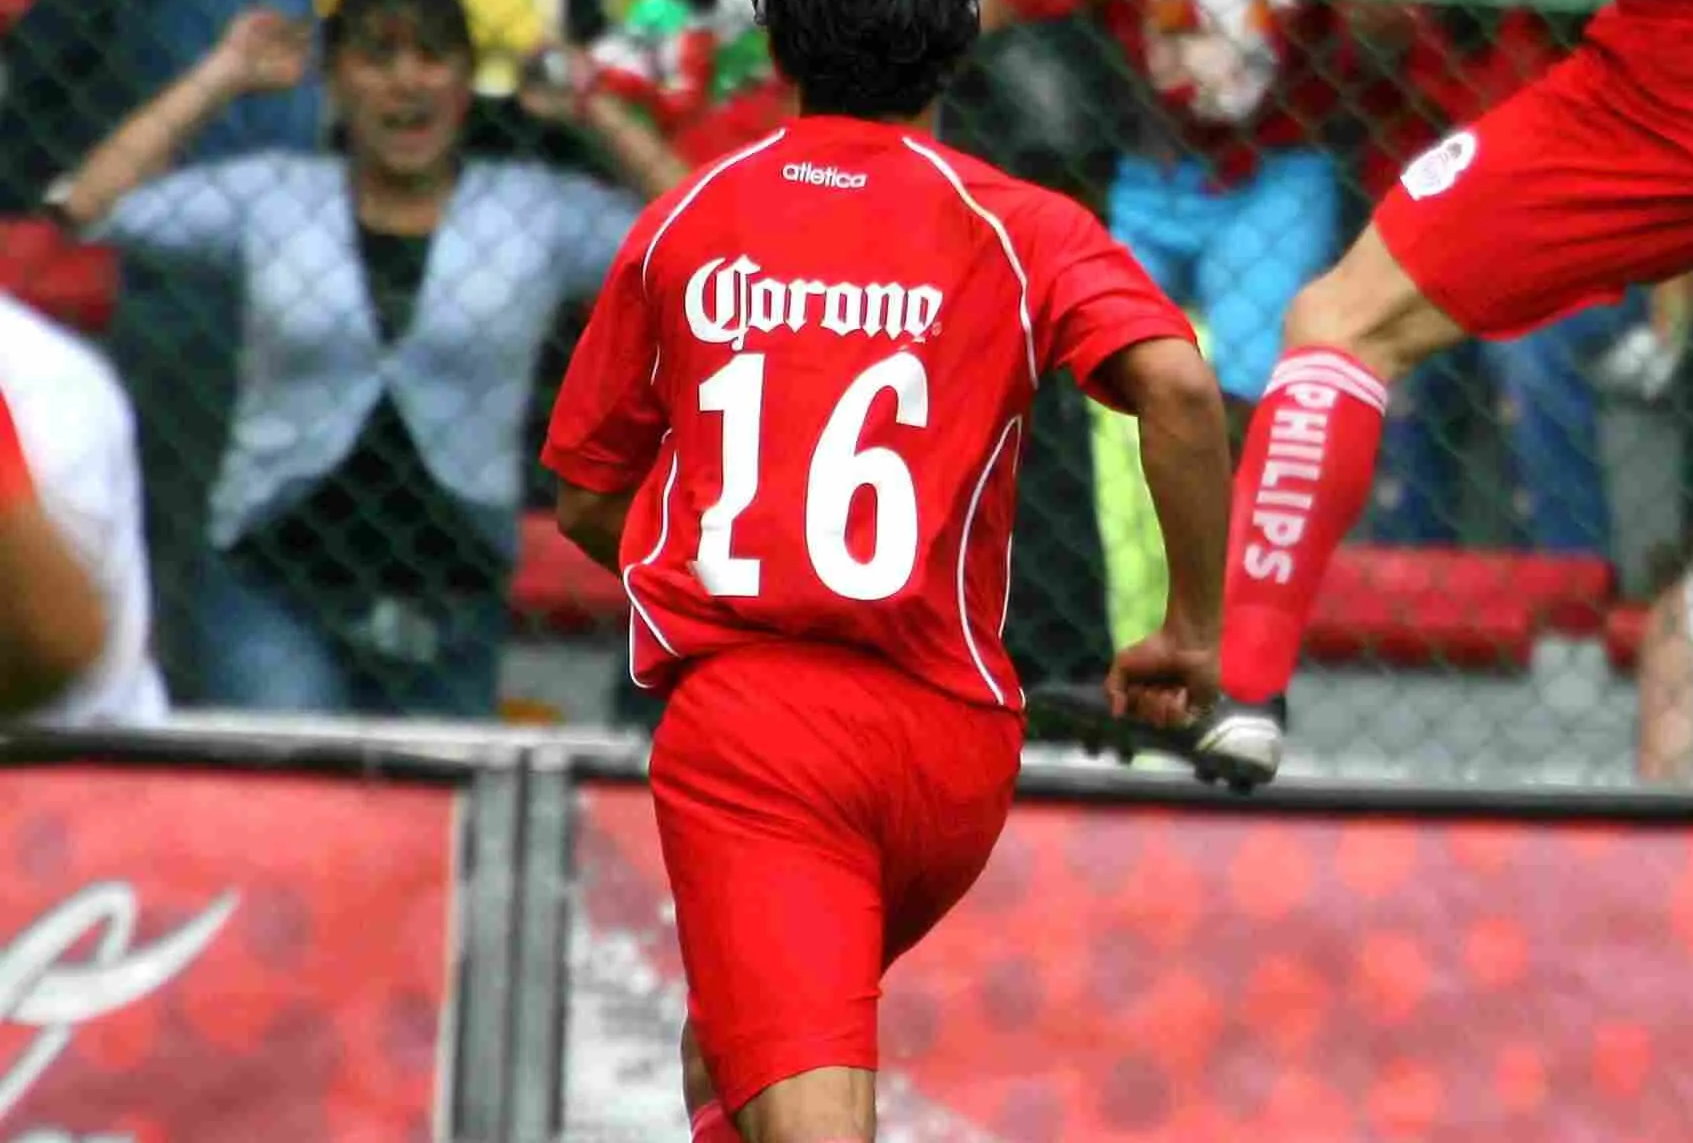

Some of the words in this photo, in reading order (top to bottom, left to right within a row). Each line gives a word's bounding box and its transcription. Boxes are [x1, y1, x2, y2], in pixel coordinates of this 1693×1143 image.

[782, 161, 868, 189] atletica
[684, 253, 943, 351] Corona
[691, 345, 928, 601] 16
[1243, 383, 1340, 585] PHILIPS
